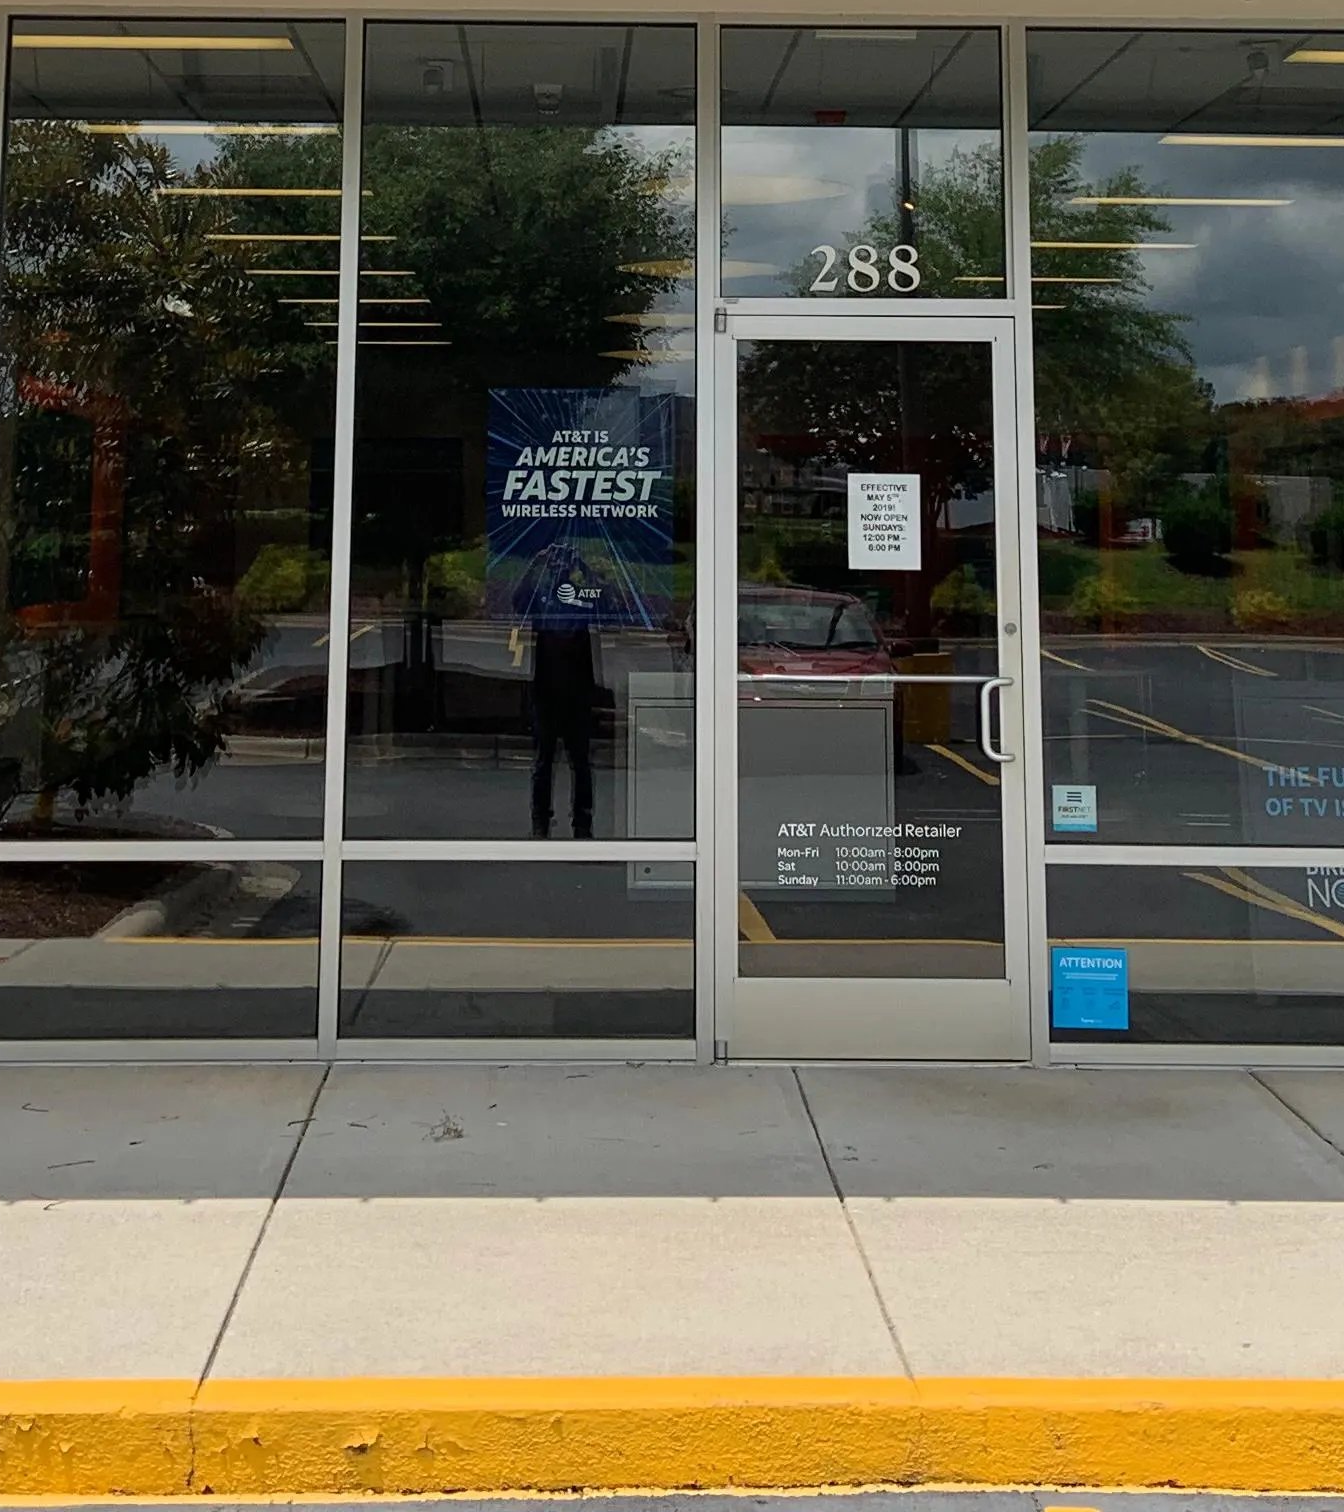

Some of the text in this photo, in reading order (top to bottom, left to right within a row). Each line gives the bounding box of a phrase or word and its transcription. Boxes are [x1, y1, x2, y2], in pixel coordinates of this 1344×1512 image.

[809, 245, 921, 292] 288
[552, 430, 609, 443] AT&T IS
[515, 446, 650, 467] AMERICA'S
[502, 470, 662, 501] FASTEST
[860, 483, 907, 492] EFFECTIVE
[867, 493, 884, 501] MAY
[502, 504, 658, 518] WIRELESS NETWORK
[863, 534, 886, 542] 12:00
[887, 534, 900, 542] PM
[888, 544, 901, 552] PM
[578, 589, 602, 599] AT&T
[1263, 766, 1311, 788] THE
[1265, 798, 1293, 816] OF
[1299, 798, 1327, 816] TV
[777, 823, 962, 838] AT&T Authorized Retailer
[777, 847, 820, 858] Mon-Fri
[835, 847, 885, 858] 10:00am
[893, 847, 939, 861] 8:00pm
[777, 861, 940, 874] Sat 10:00am 8:00pm
[777, 875, 819, 887] Sunday
[835, 875, 883, 885] 11:00am
[891, 875, 936, 888] 6:00pm
[1059, 957, 1123, 969] ATTENTION
